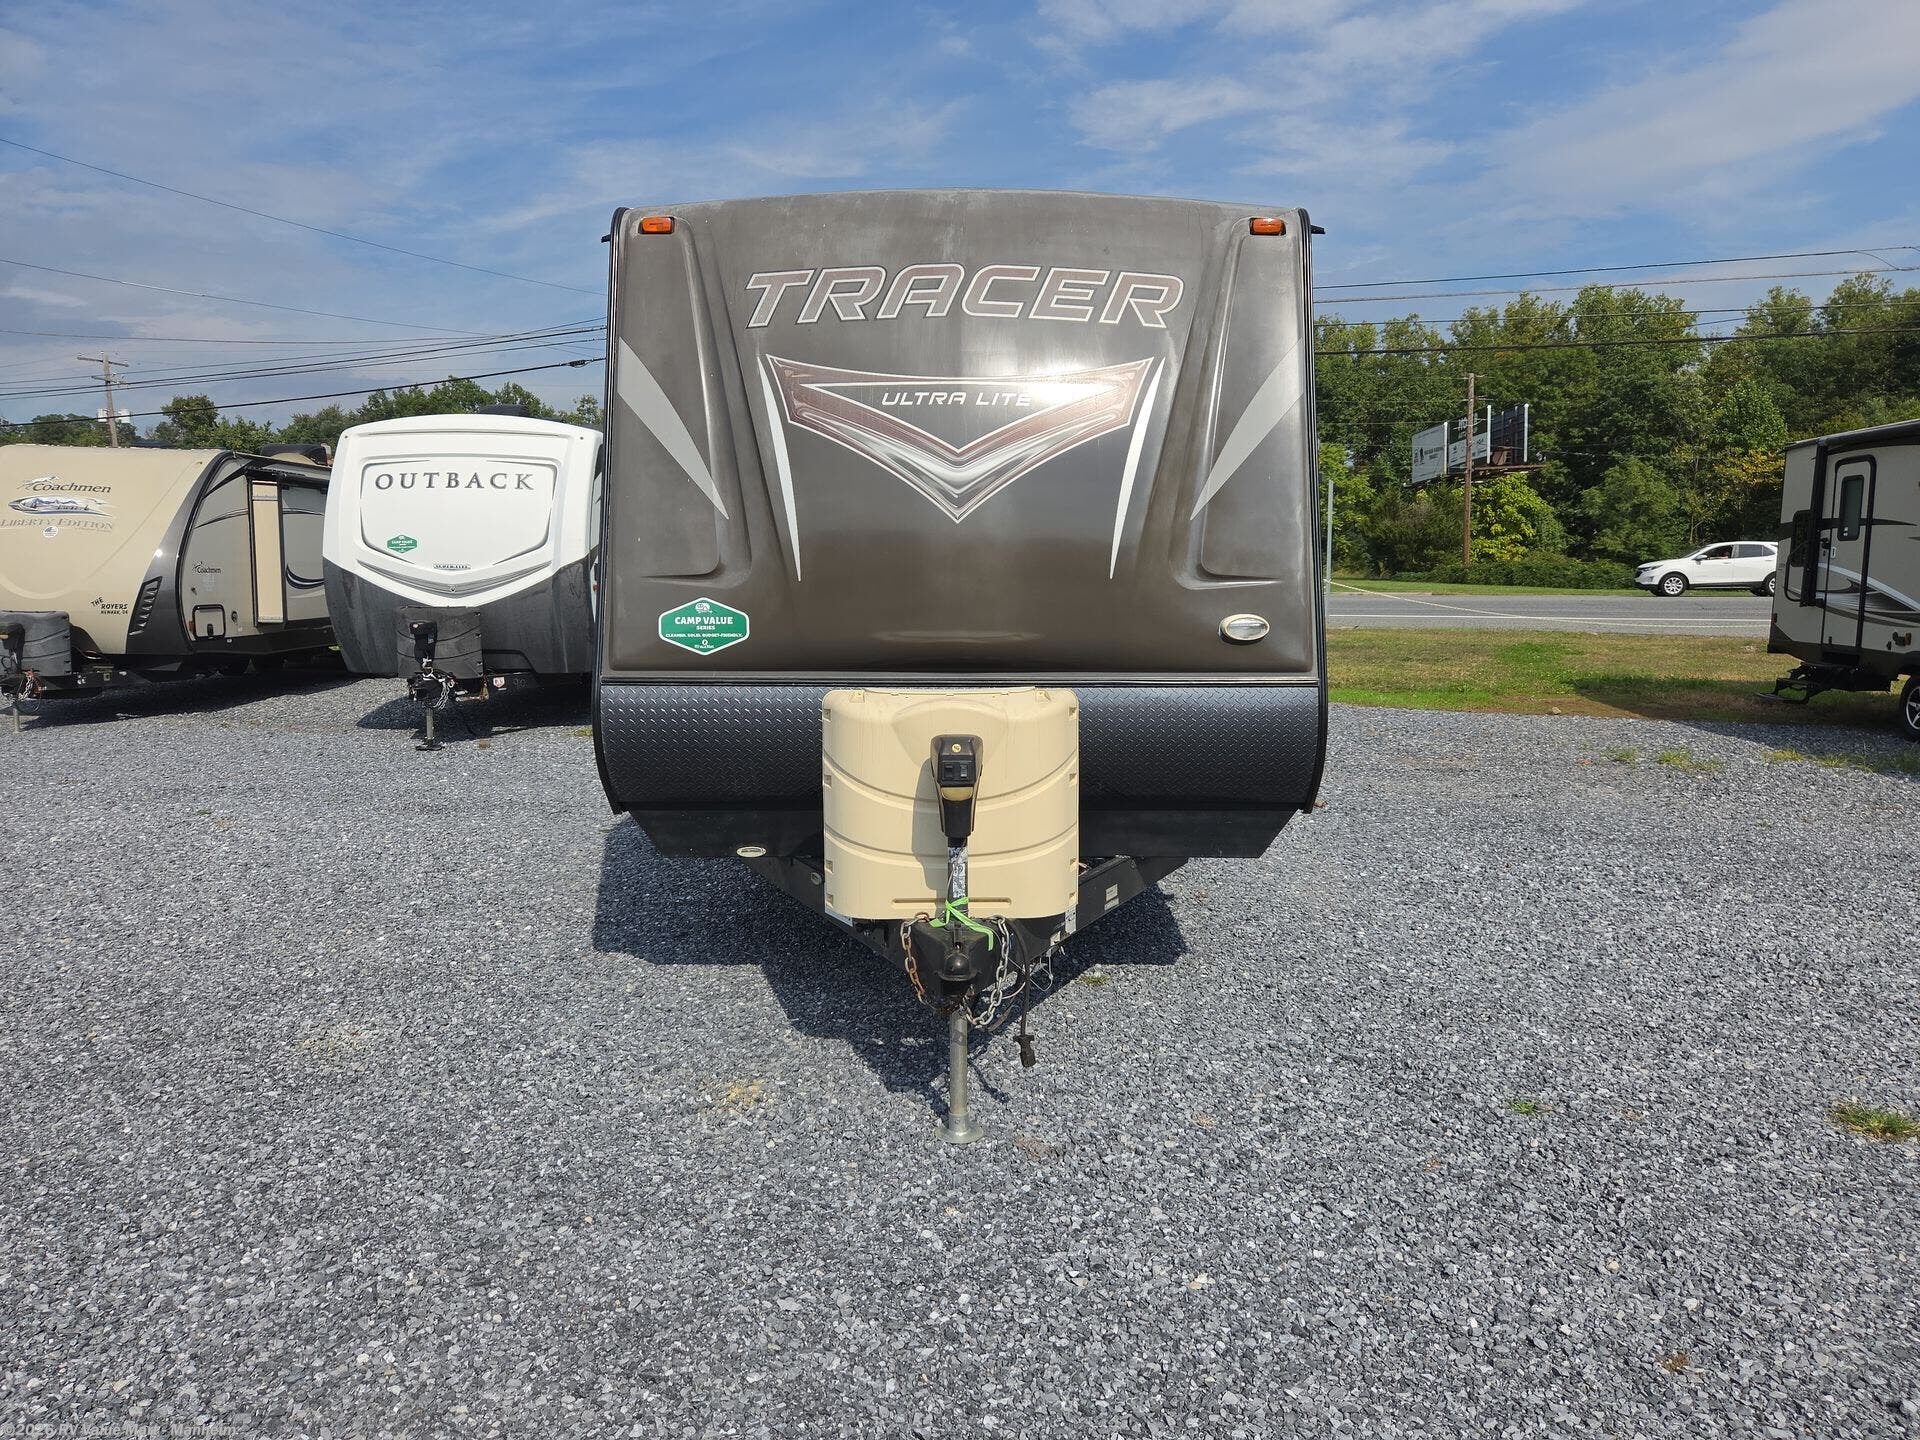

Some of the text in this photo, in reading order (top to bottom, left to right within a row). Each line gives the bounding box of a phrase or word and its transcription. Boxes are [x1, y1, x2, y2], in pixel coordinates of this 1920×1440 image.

[745, 263, 1185, 329] TRACER
[881, 391, 1033, 407] ULTRA LITE
[32, 482, 112, 493] Coachmen
[375, 472, 534, 490] OUTBACK
[90, 596, 104, 607] THE
[674, 616, 734, 625] CAMP VALUE
